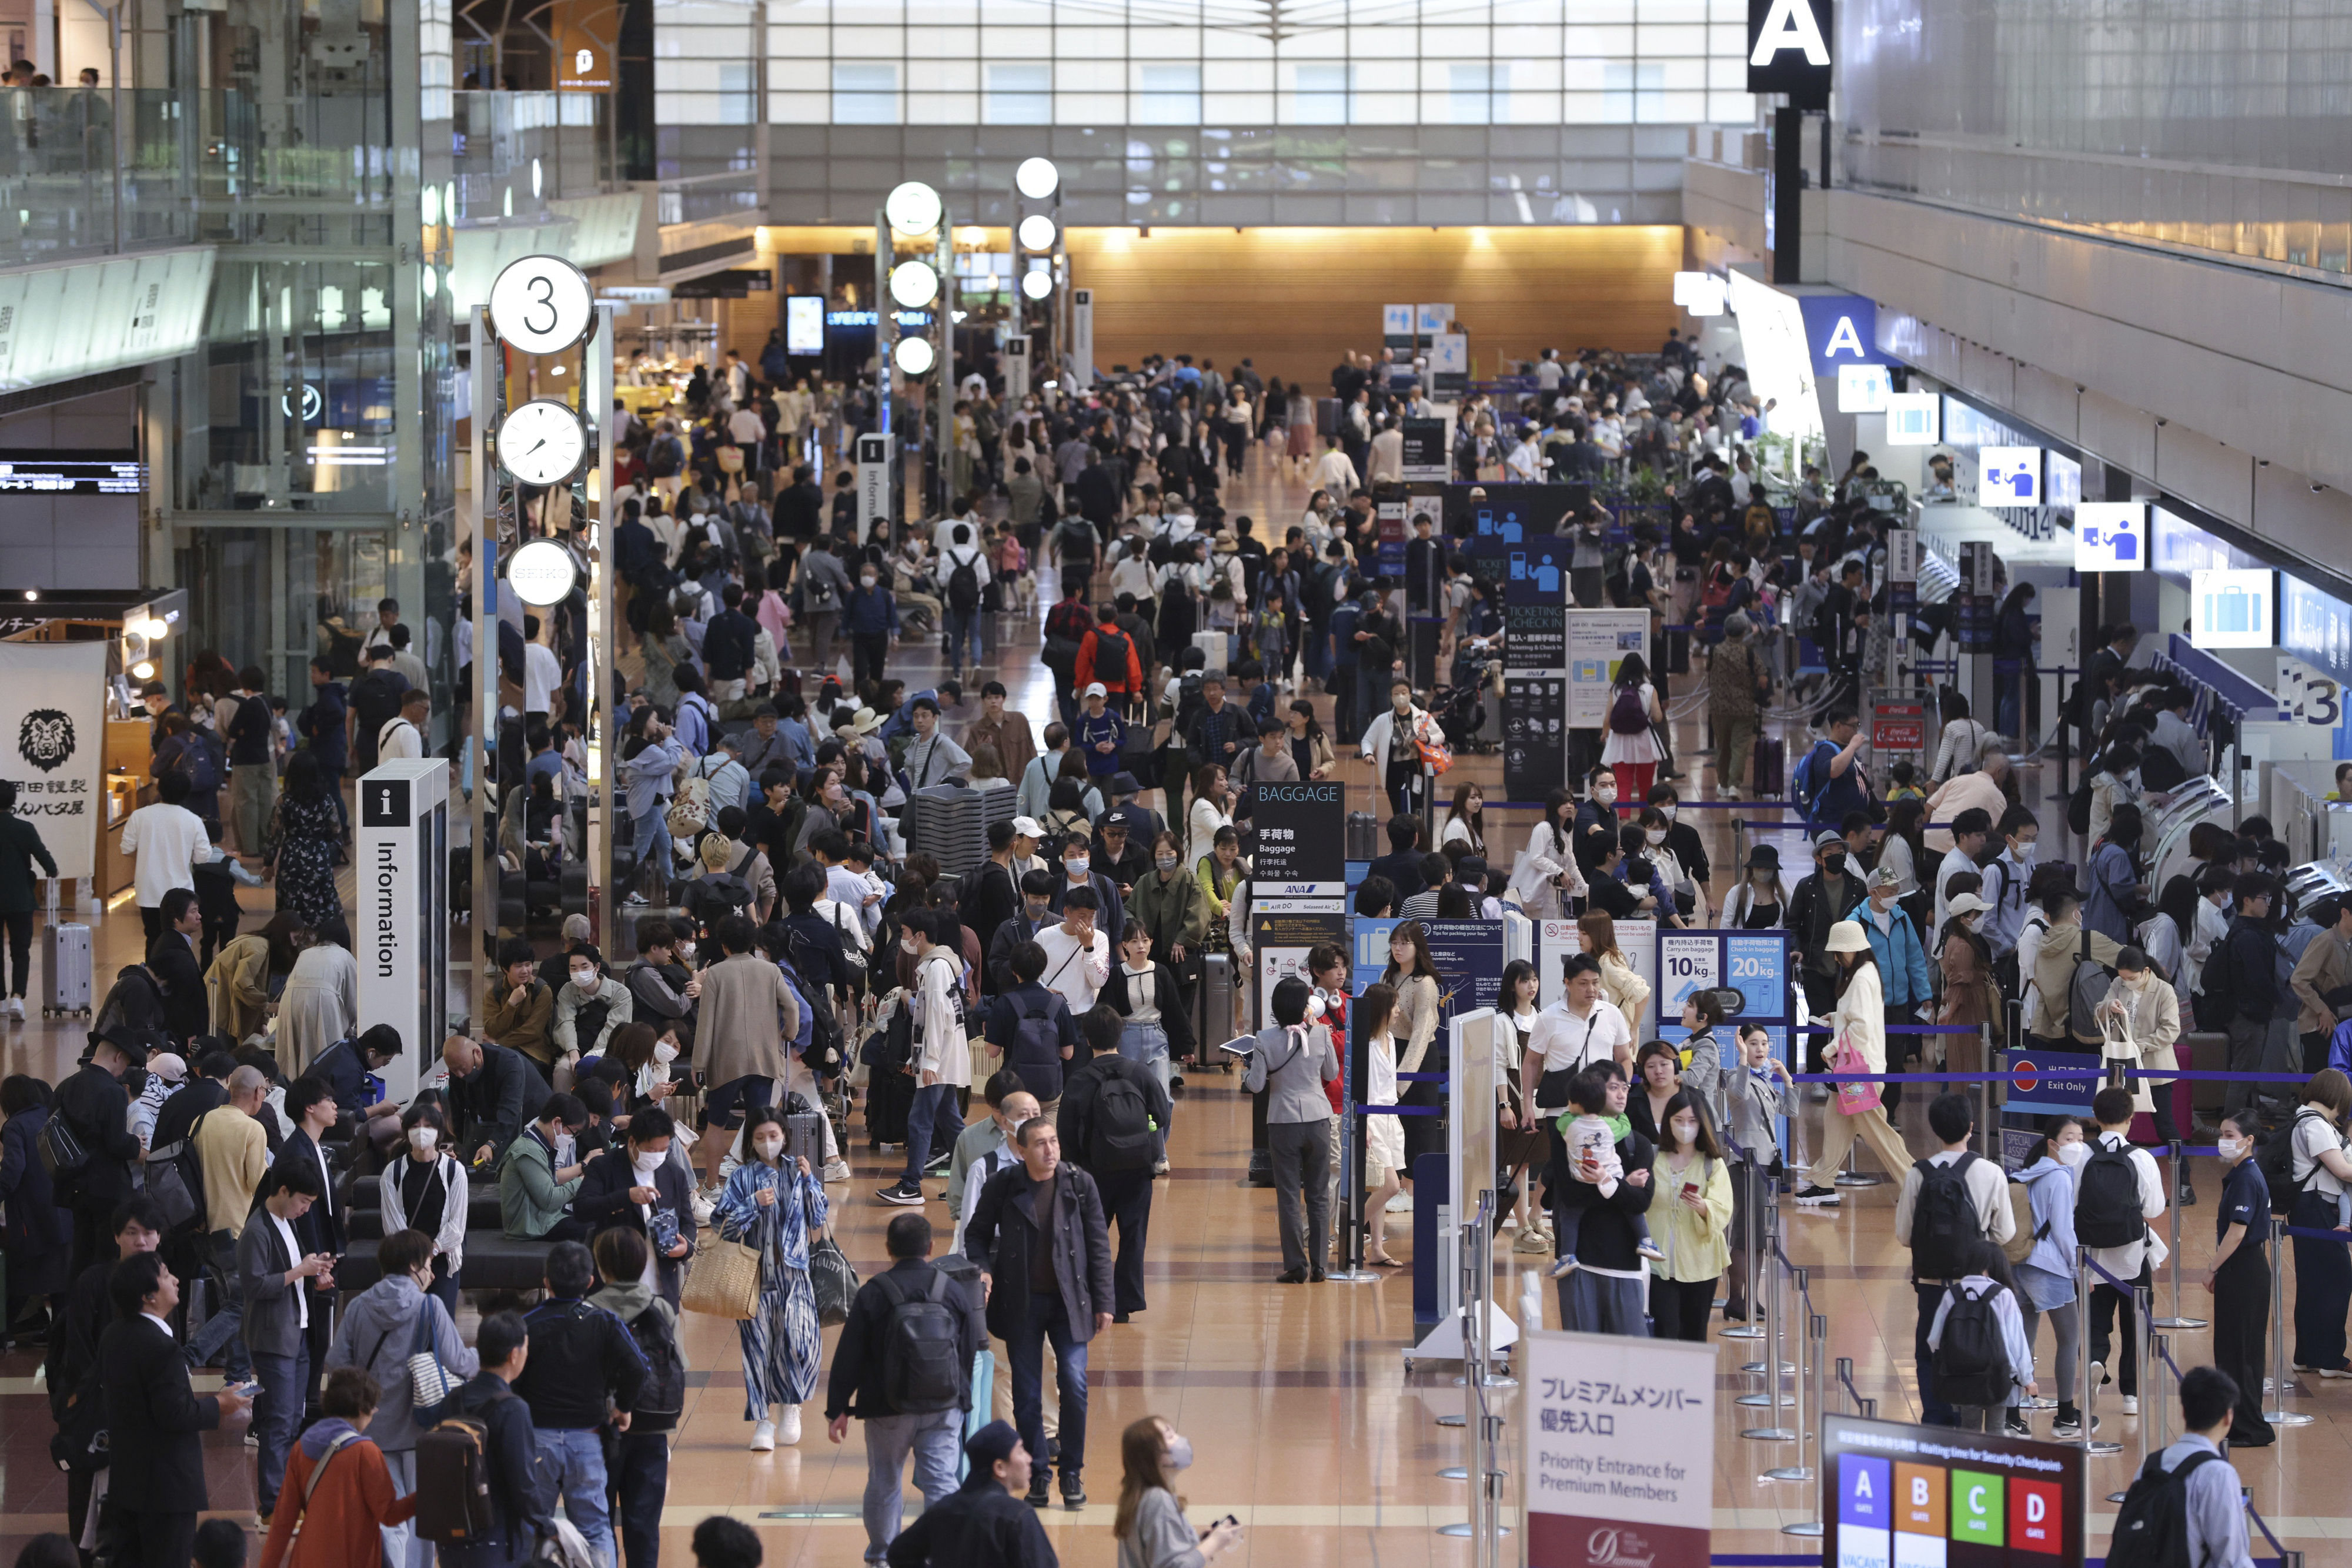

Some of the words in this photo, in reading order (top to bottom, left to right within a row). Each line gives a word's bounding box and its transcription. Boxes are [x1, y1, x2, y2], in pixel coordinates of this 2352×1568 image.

[1750, 0, 1830, 66] A
[524, 276, 558, 335] 3
[1825, 316, 1865, 357] A
[868, 470, 878, 523] Informa
[515, 568, 568, 579] SEIKO
[1476, 560, 1506, 568] TICKET
[1509, 606, 1562, 616] TICKETING
[1552, 618, 1562, 628] IN
[2306, 679, 2339, 725] 3
[1259, 786, 1338, 801] BAGGAGE
[1259, 828, 1294, 840] 手荷物
[1259, 844, 1295, 854] Baggage
[378, 842, 397, 977] Information
[2048, 1081, 2064, 1090] Exit
[2066, 1082, 2086, 1093] Only
[1342, 1054, 1351, 1156] ENTRANCE
[2007, 1134, 2033, 1147] SPECIAL
[2008, 1146, 2027, 1158] ASSIST
[1541, 1378, 1703, 1410] プレミアムメンバー
[1540, 1408, 1614, 1436] 優先入口
[1540, 1452, 1593, 1475] Priority
[1598, 1457, 1661, 1479] Entrance
[1665, 1462, 1686, 1480] for
[1981, 1450, 2015, 1468] Security
[1540, 1473, 1606, 1496] Premium
[1610, 1481, 1678, 1502] Members
[1855, 1470, 1873, 1498] A
[1912, 1477, 1929, 1506] B
[1969, 1485, 1986, 1514] C
[2027, 1493, 2045, 1522] D
[1855, 1503, 1873, 1514] GATE
[1911, 1511, 1929, 1523] GATE
[1968, 1519, 1987, 1531] GATE
[2026, 1527, 2045, 1539] GATE
